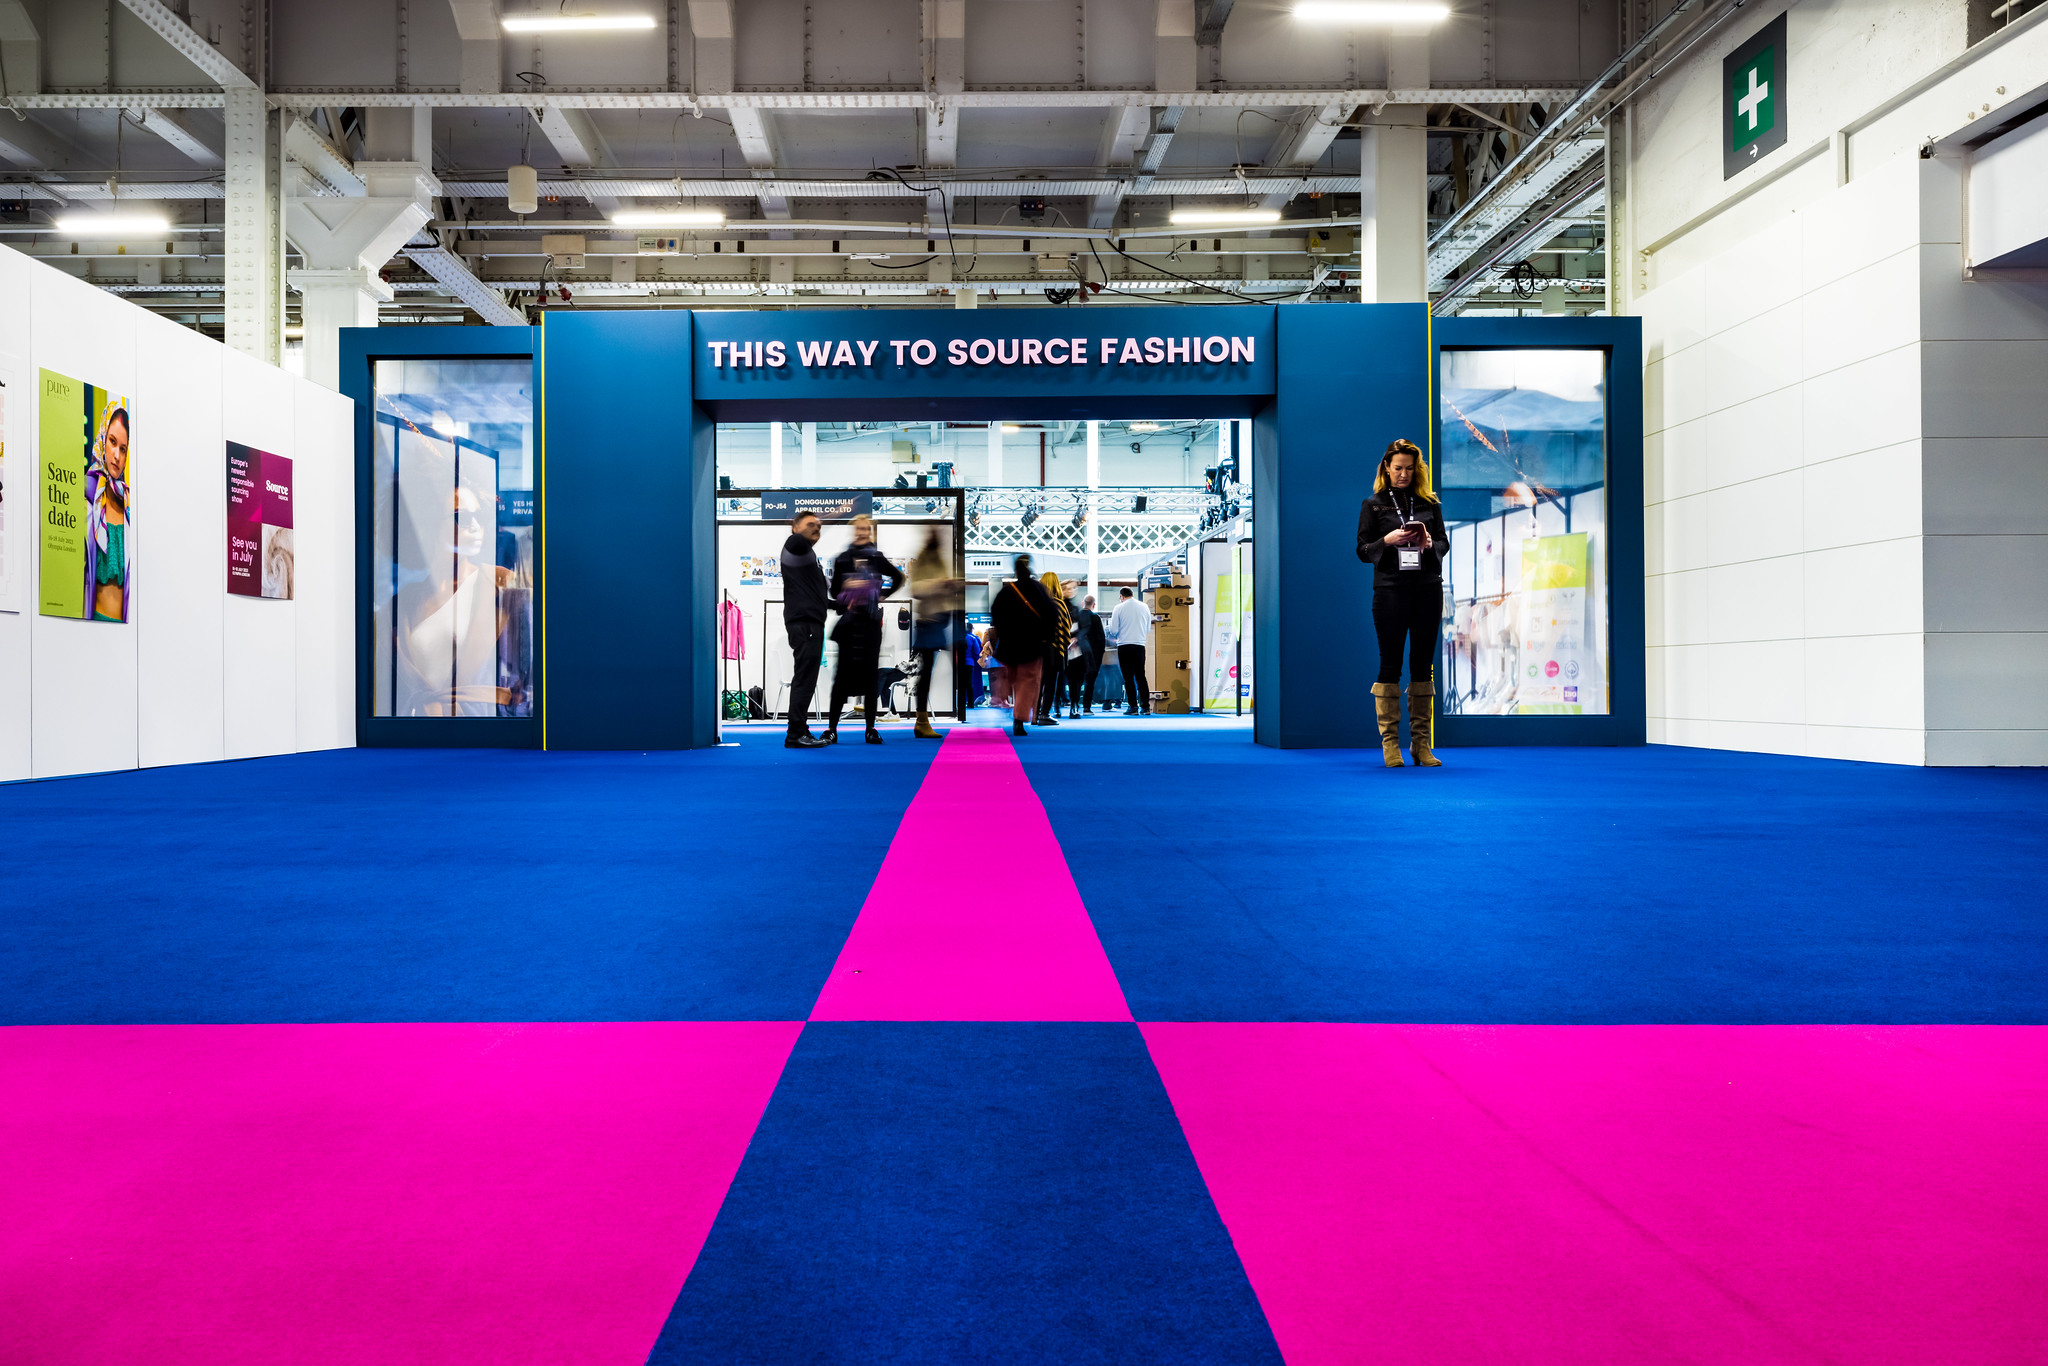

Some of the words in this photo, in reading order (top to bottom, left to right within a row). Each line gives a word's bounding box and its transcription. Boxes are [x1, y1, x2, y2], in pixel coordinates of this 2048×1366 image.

[708, 341, 786, 368] THIS
[797, 341, 878, 367] WAY
[890, 340, 937, 366] TO
[948, 338, 1088, 366] SOURCE
[1102, 336, 1255, 364] FASHION
[47, 379, 70, 397] pure
[231, 457, 248, 468] Europe's
[47, 462, 77, 486] Save
[231, 468, 246, 476] newest
[231, 477, 254, 488] responsible
[266, 480, 288, 495] Source
[47, 484, 70, 506] the
[232, 487, 249, 498] sourcing
[232, 495, 242, 503] show
[48, 506, 77, 529] date
[232, 536, 244, 549] See
[245, 540, 257, 552] you
[232, 549, 238, 560] in
[240, 551, 253, 566] July
